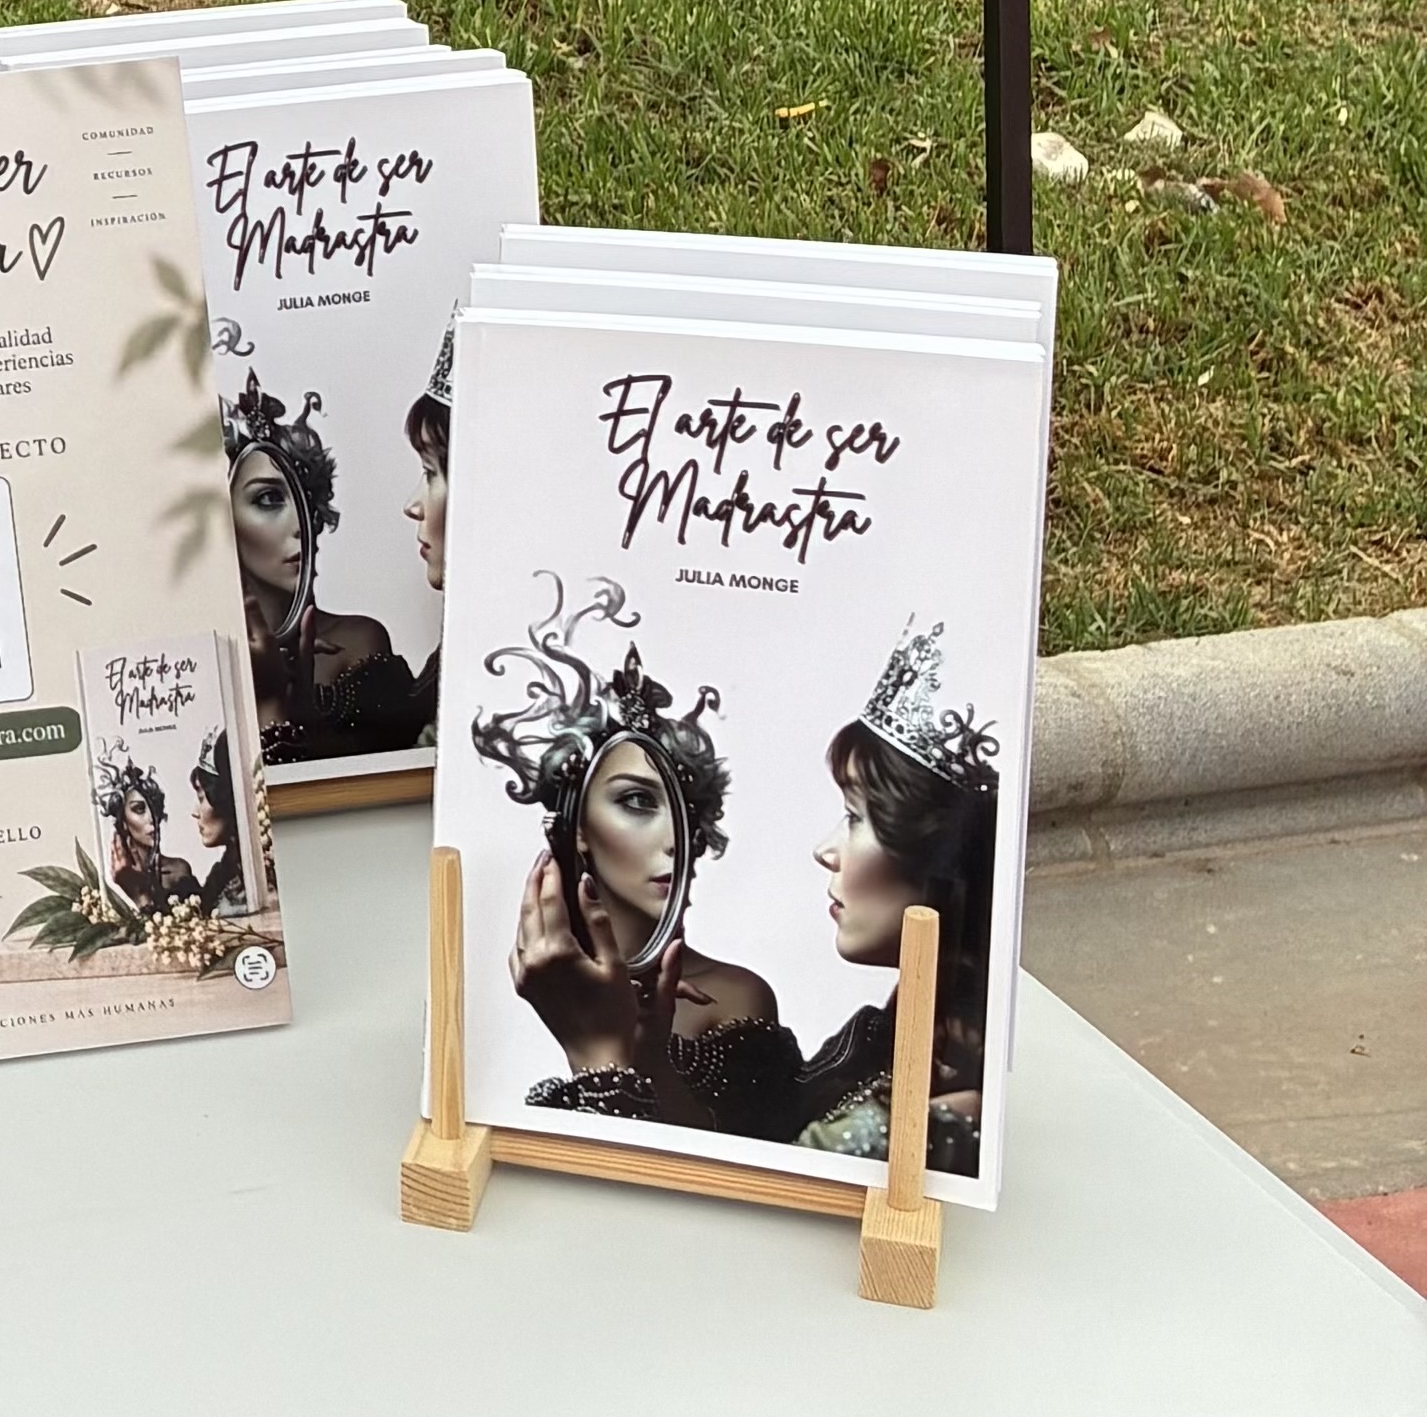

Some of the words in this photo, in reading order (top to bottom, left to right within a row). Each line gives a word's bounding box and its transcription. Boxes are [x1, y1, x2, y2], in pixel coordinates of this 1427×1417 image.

[81, 126, 154, 141] COMUNIDAD
[206, 140, 259, 214] El
[263, 141, 342, 216] arte
[333, 136, 368, 204] de
[377, 150, 433, 197] ser
[227, 201, 419, 291] Madrastra
[277, 296, 315, 311] JULIA
[317, 290, 371, 307] MONGE
[599, 374, 673, 462] El
[674, 387, 781, 475] arte
[767, 392, 814, 471] de
[826, 421, 900, 471] ser
[618, 457, 872, 565] Madrastra
[674, 568, 725, 587] JULIA
[728, 573, 799, 594] MONGE
